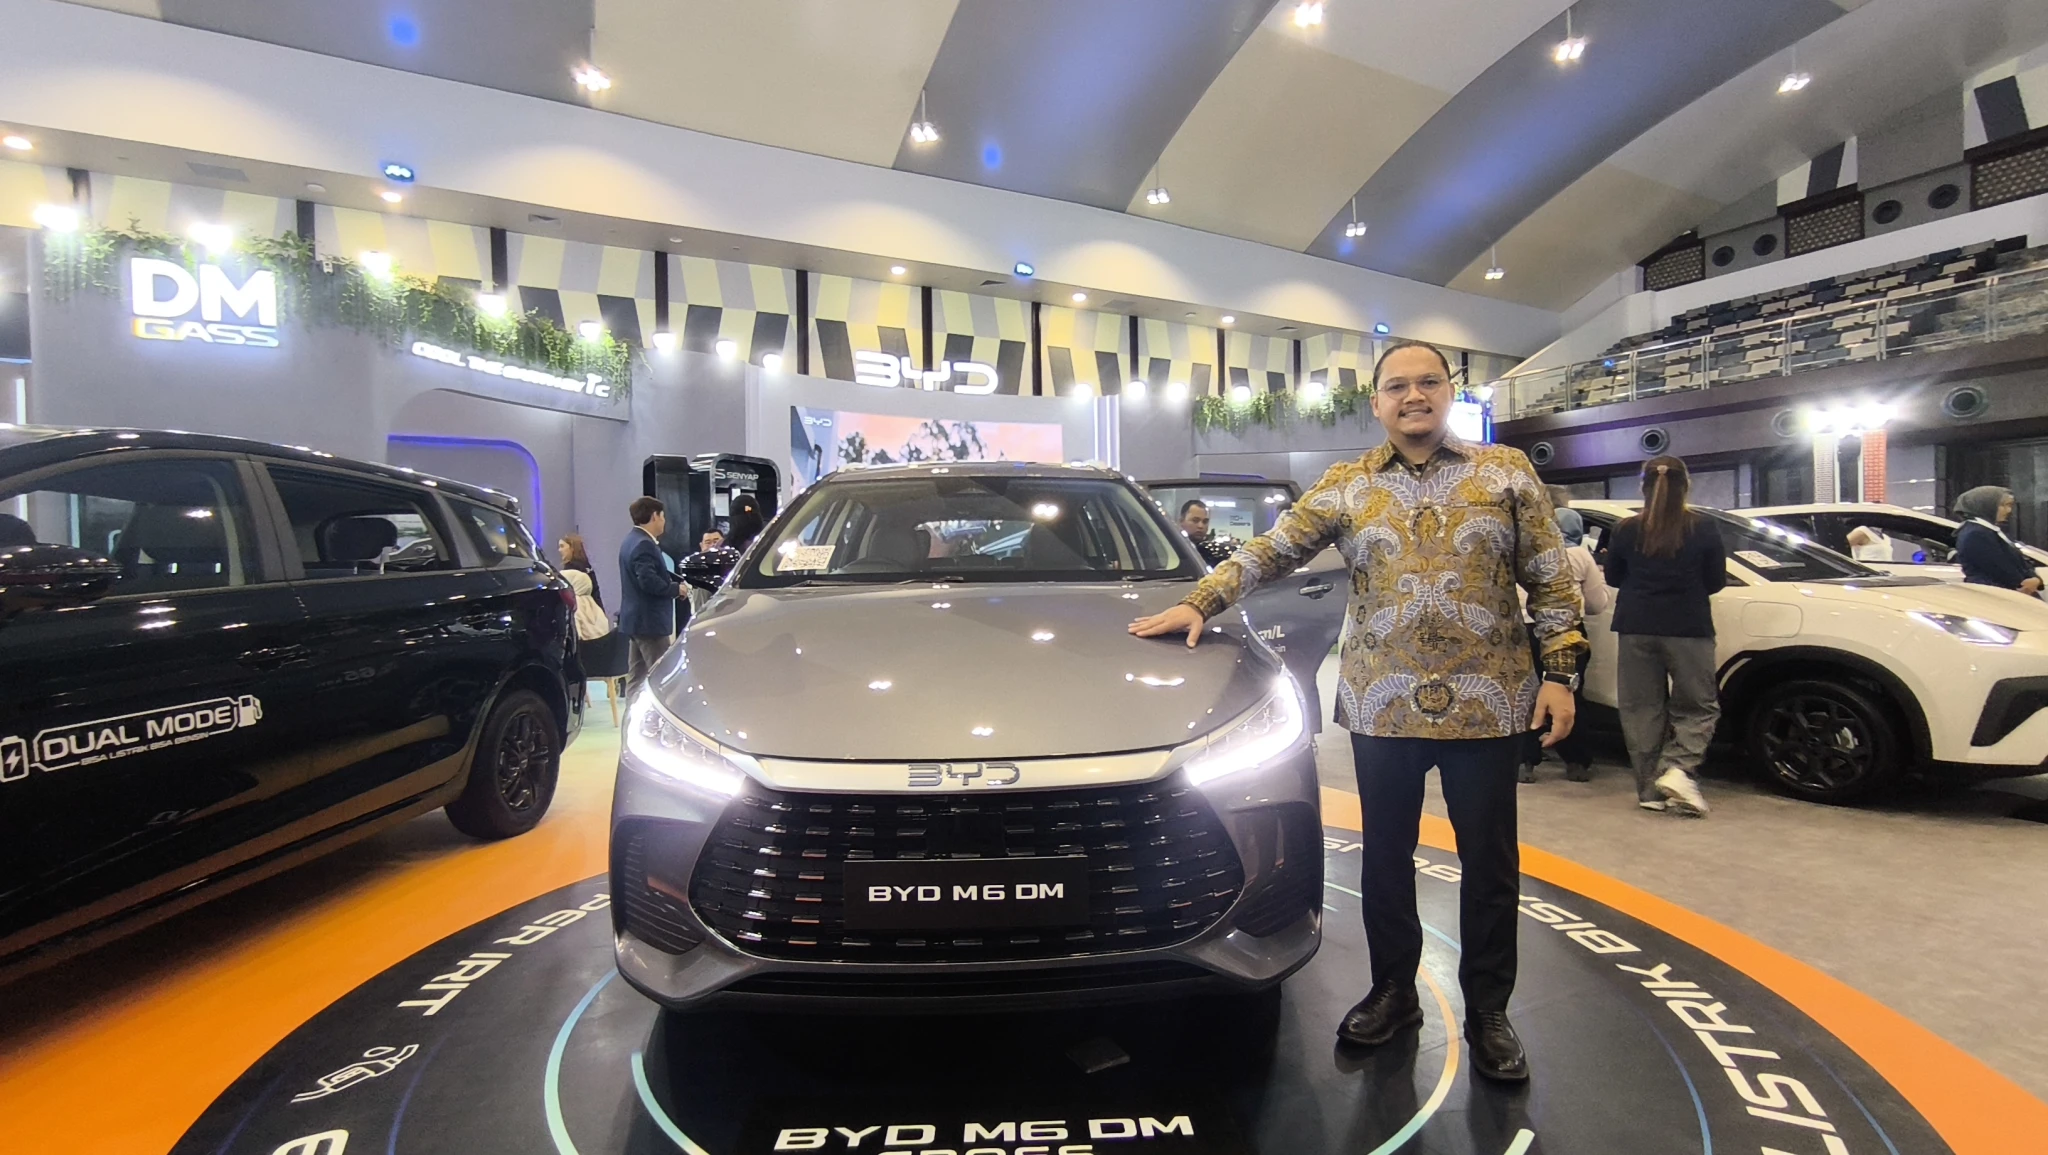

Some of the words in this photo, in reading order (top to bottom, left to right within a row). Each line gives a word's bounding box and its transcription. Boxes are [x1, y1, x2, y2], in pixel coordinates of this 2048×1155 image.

[131, 257, 277, 326] DM
[132, 317, 280, 348] GASS
[855, 350, 998, 395] BYD
[803, 415, 833, 427] BYD
[726, 471, 759, 481] SENYAP
[42, 725, 140, 761] DUAL
[146, 705, 232, 739] MODE
[908, 762, 1020, 787] BYD
[868, 885, 941, 902] BYD
[953, 884, 1006, 901] M6
[1015, 883, 1064, 899] DM
[397, 952, 513, 1016] IRIT
[773, 1124, 936, 1150] BYD
[963, 1120, 1069, 1143] M6
[1087, 1115, 1195, 1139] DM
